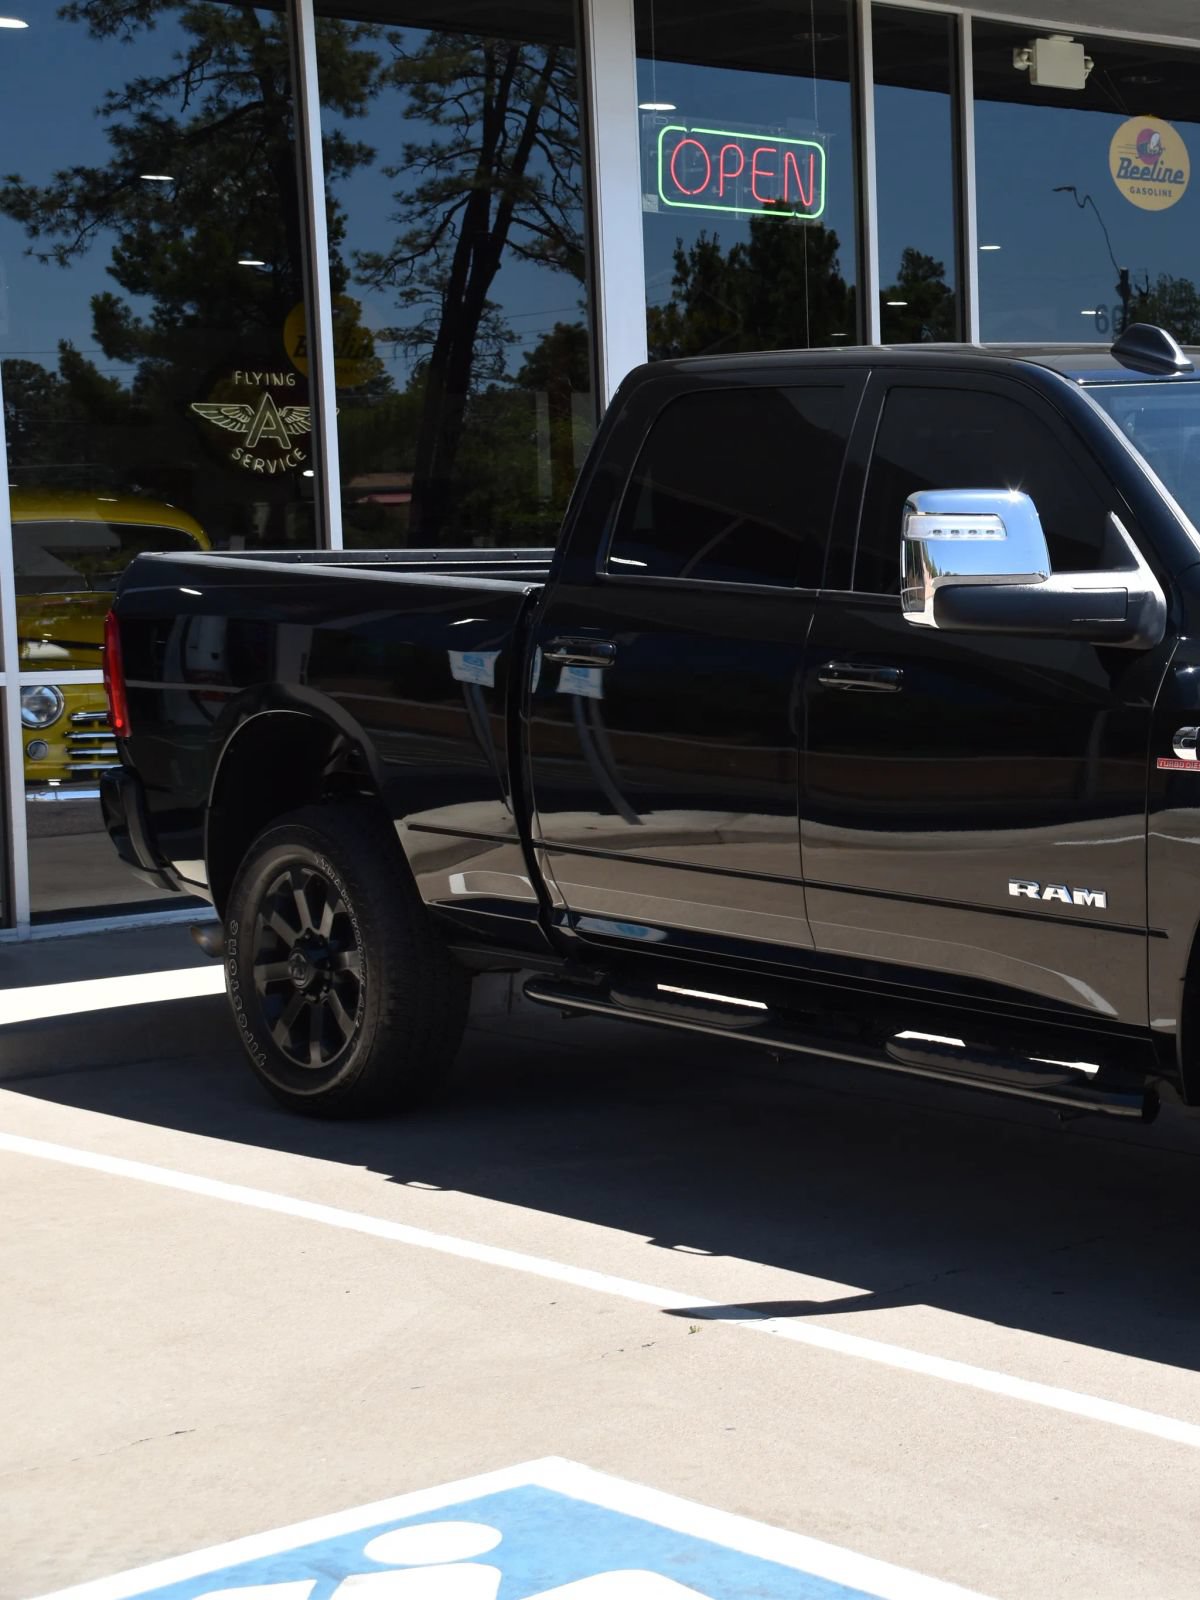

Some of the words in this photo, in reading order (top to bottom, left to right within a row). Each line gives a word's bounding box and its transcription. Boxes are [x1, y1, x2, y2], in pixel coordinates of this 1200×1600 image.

[670, 139, 814, 207] OPEN
[1116, 156, 1185, 185] Beeline
[1129, 186, 1173, 198] GASOLINE
[234, 370, 296, 387] FLYING
[246, 391, 292, 450] A
[231, 447, 307, 474] SERVICE
[1159, 760, 1185, 769] TURBO
[1008, 879, 1107, 909] RAM
